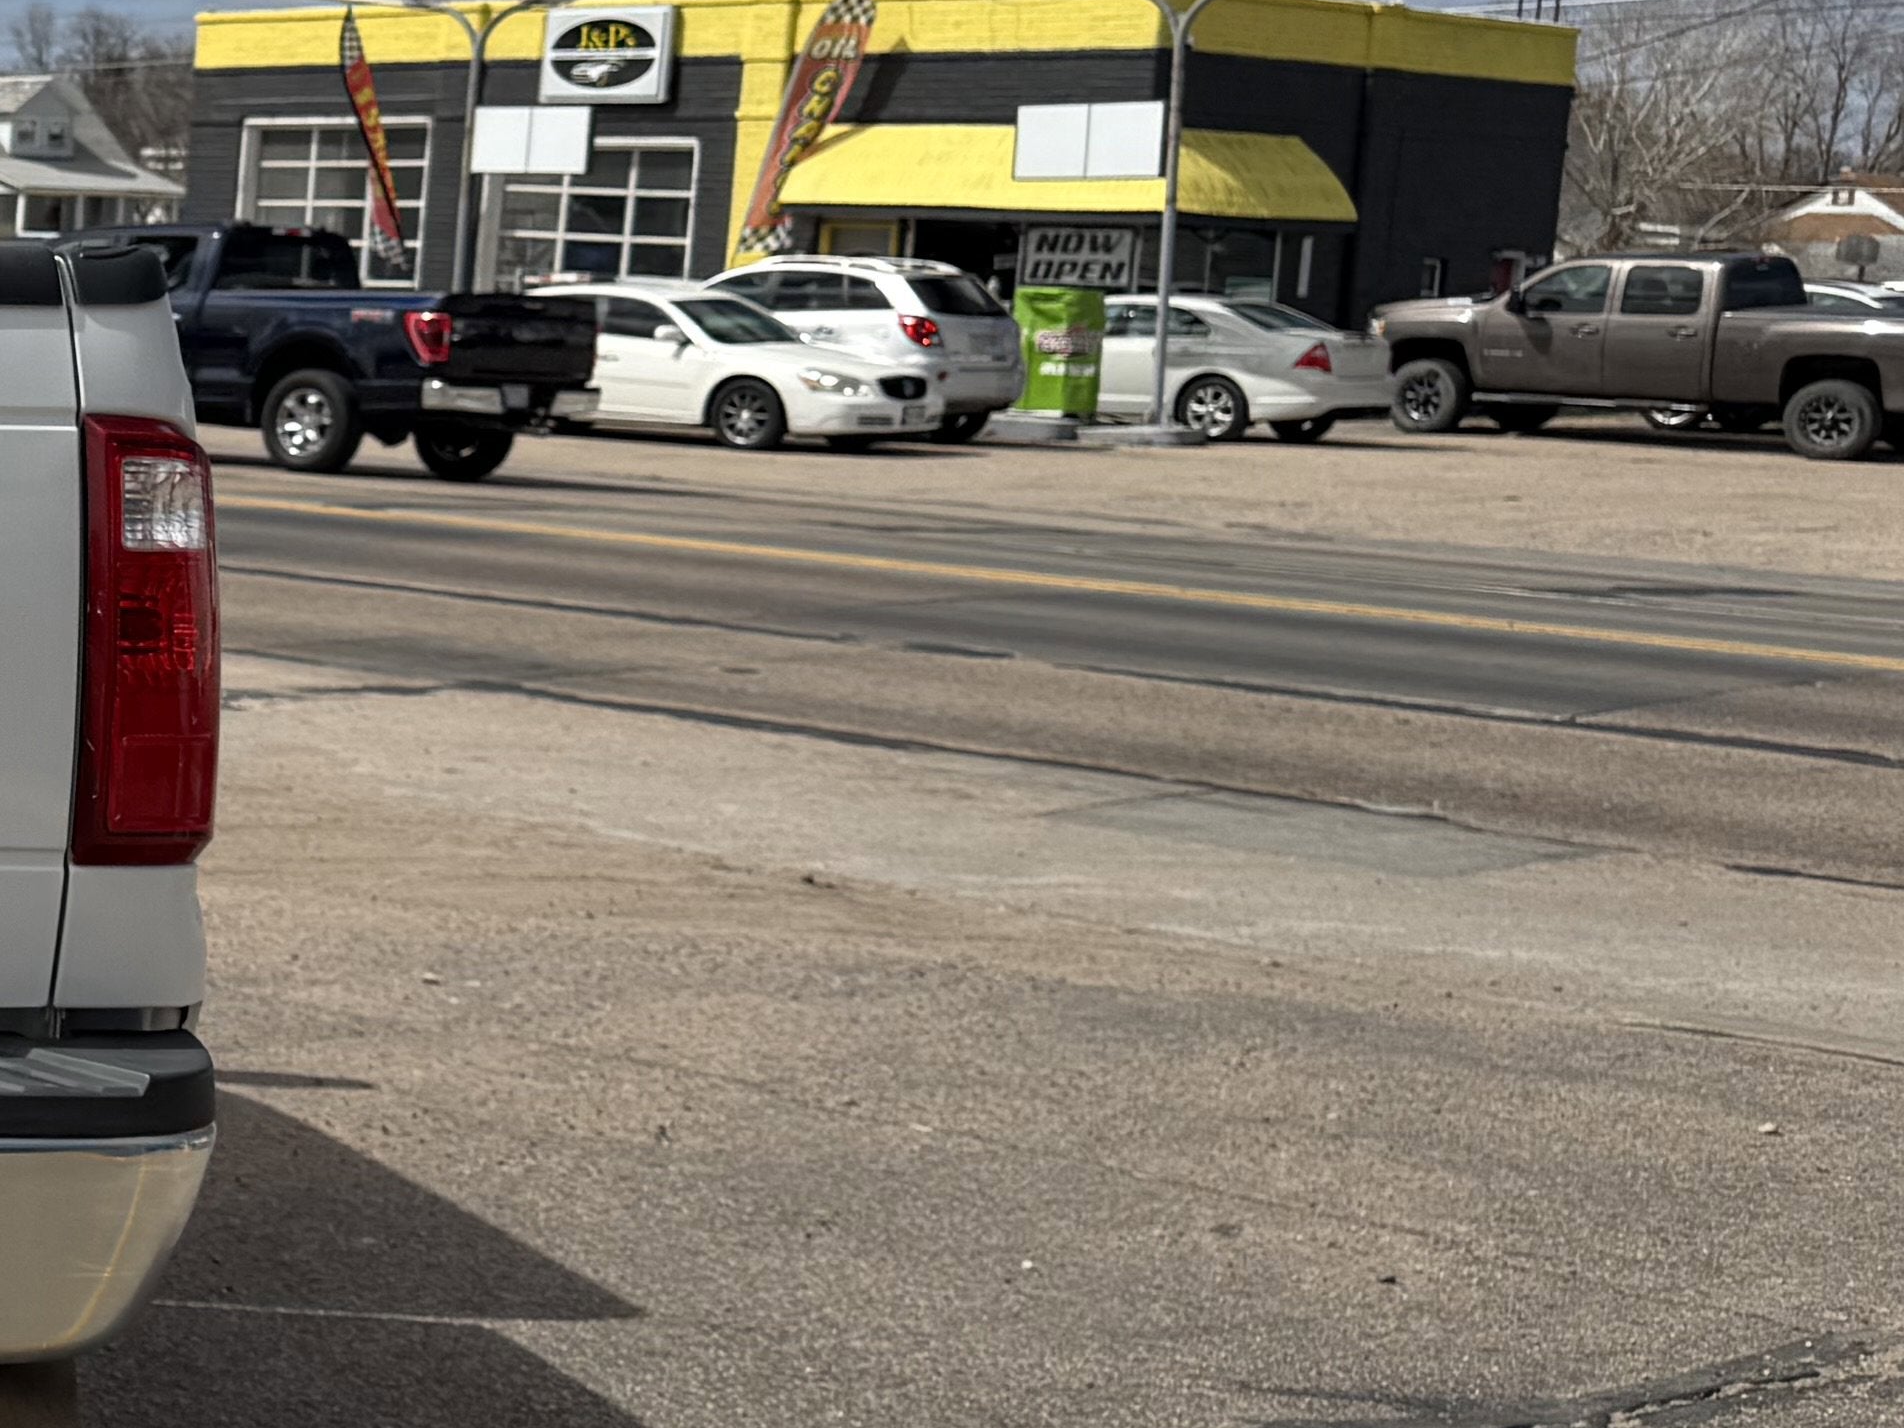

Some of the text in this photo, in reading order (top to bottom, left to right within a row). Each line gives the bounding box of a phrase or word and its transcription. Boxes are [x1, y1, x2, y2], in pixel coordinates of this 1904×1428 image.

[810, 36, 859, 60] OIL
[1036, 233, 1122, 254] NOW
[1029, 260, 1126, 280] OPEN
